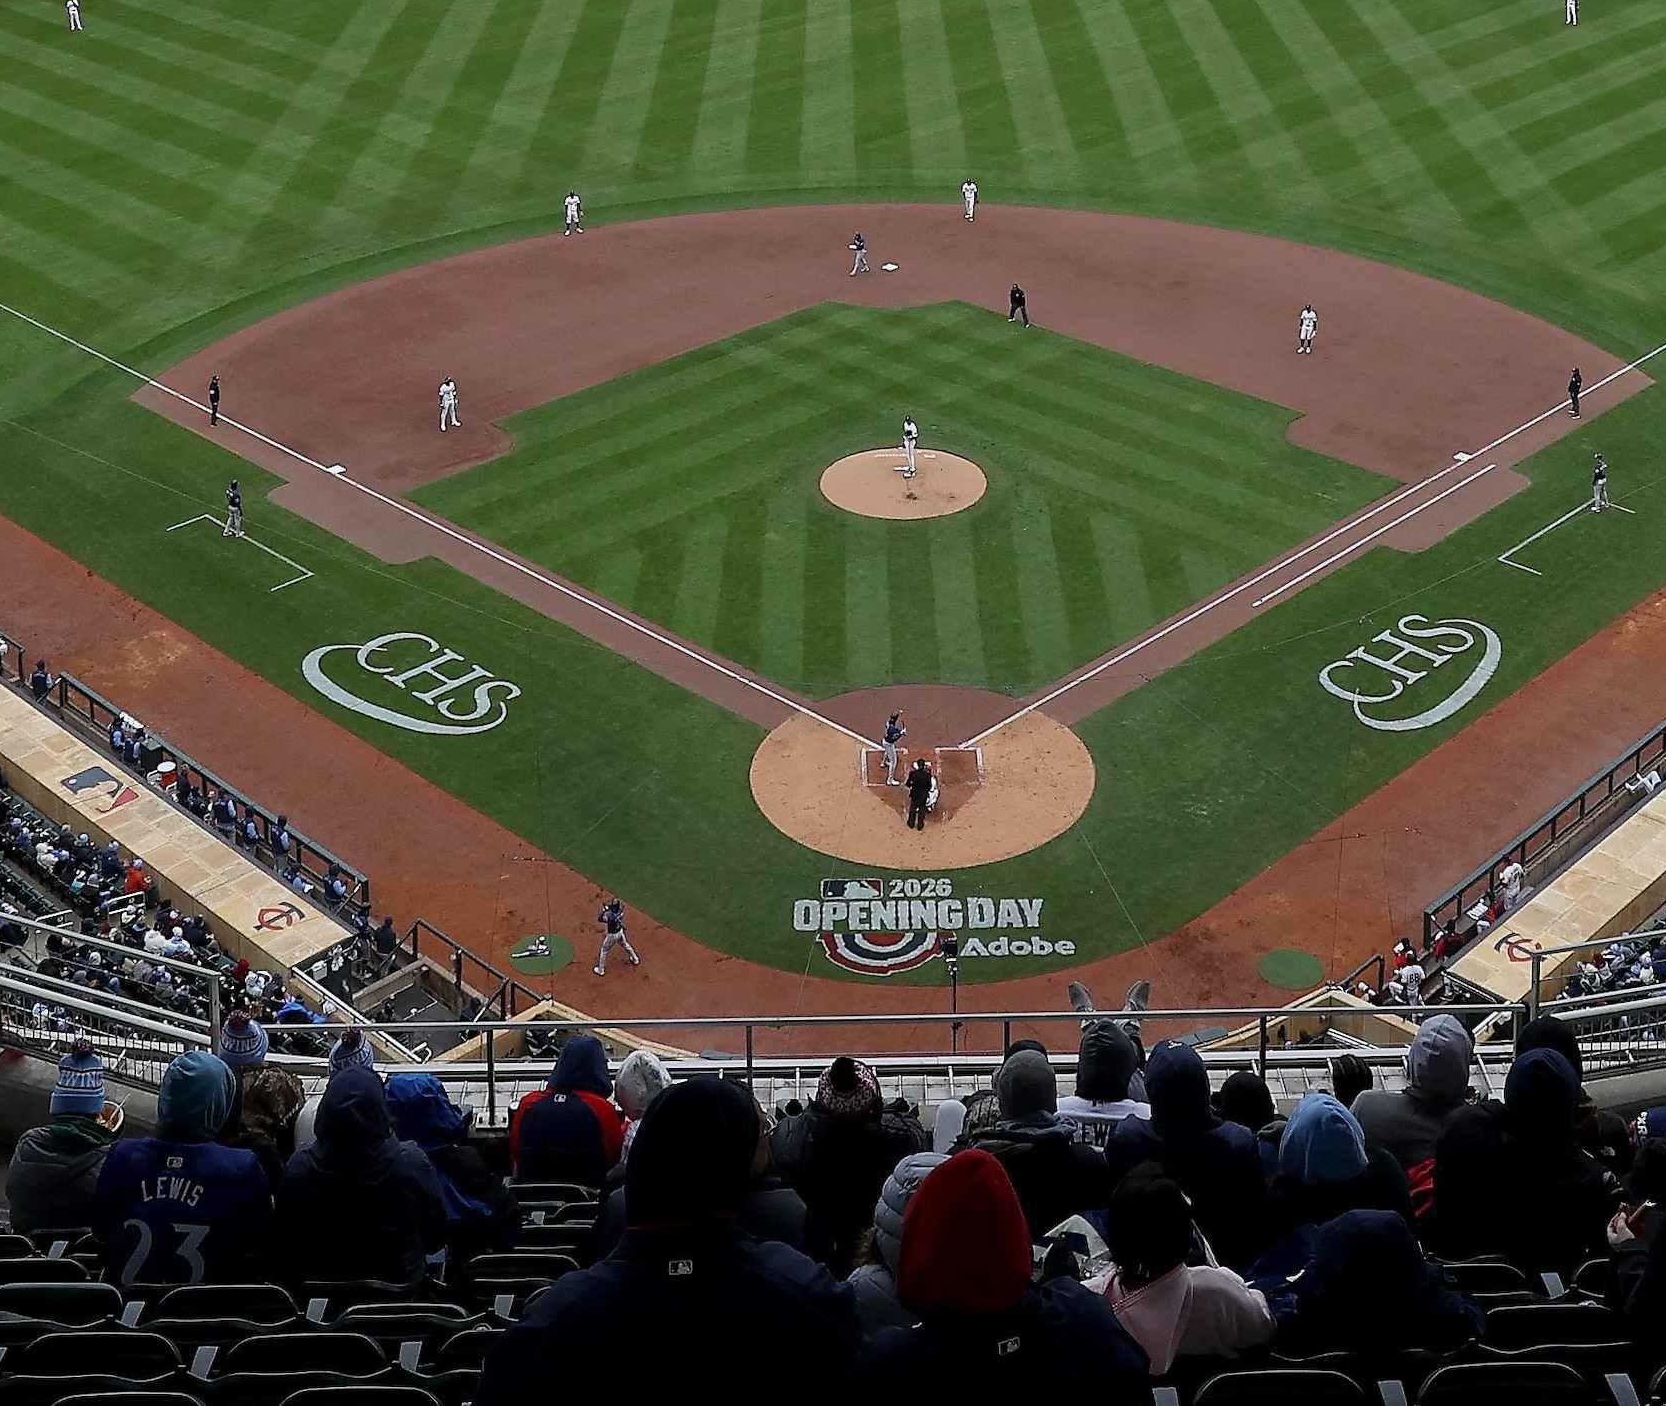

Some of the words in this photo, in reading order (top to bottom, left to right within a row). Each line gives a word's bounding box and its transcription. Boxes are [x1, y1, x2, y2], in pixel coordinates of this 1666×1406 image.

[356, 631, 522, 721] CHS
[1318, 614, 1475, 704] CHS
[889, 878, 953, 898] 2026
[793, 898, 964, 932] OPENING
[967, 897, 1044, 930] DAY
[960, 936, 1077, 956] Adobe
[141, 1176, 203, 1206] LEWIS
[121, 1219, 210, 1285] 23
